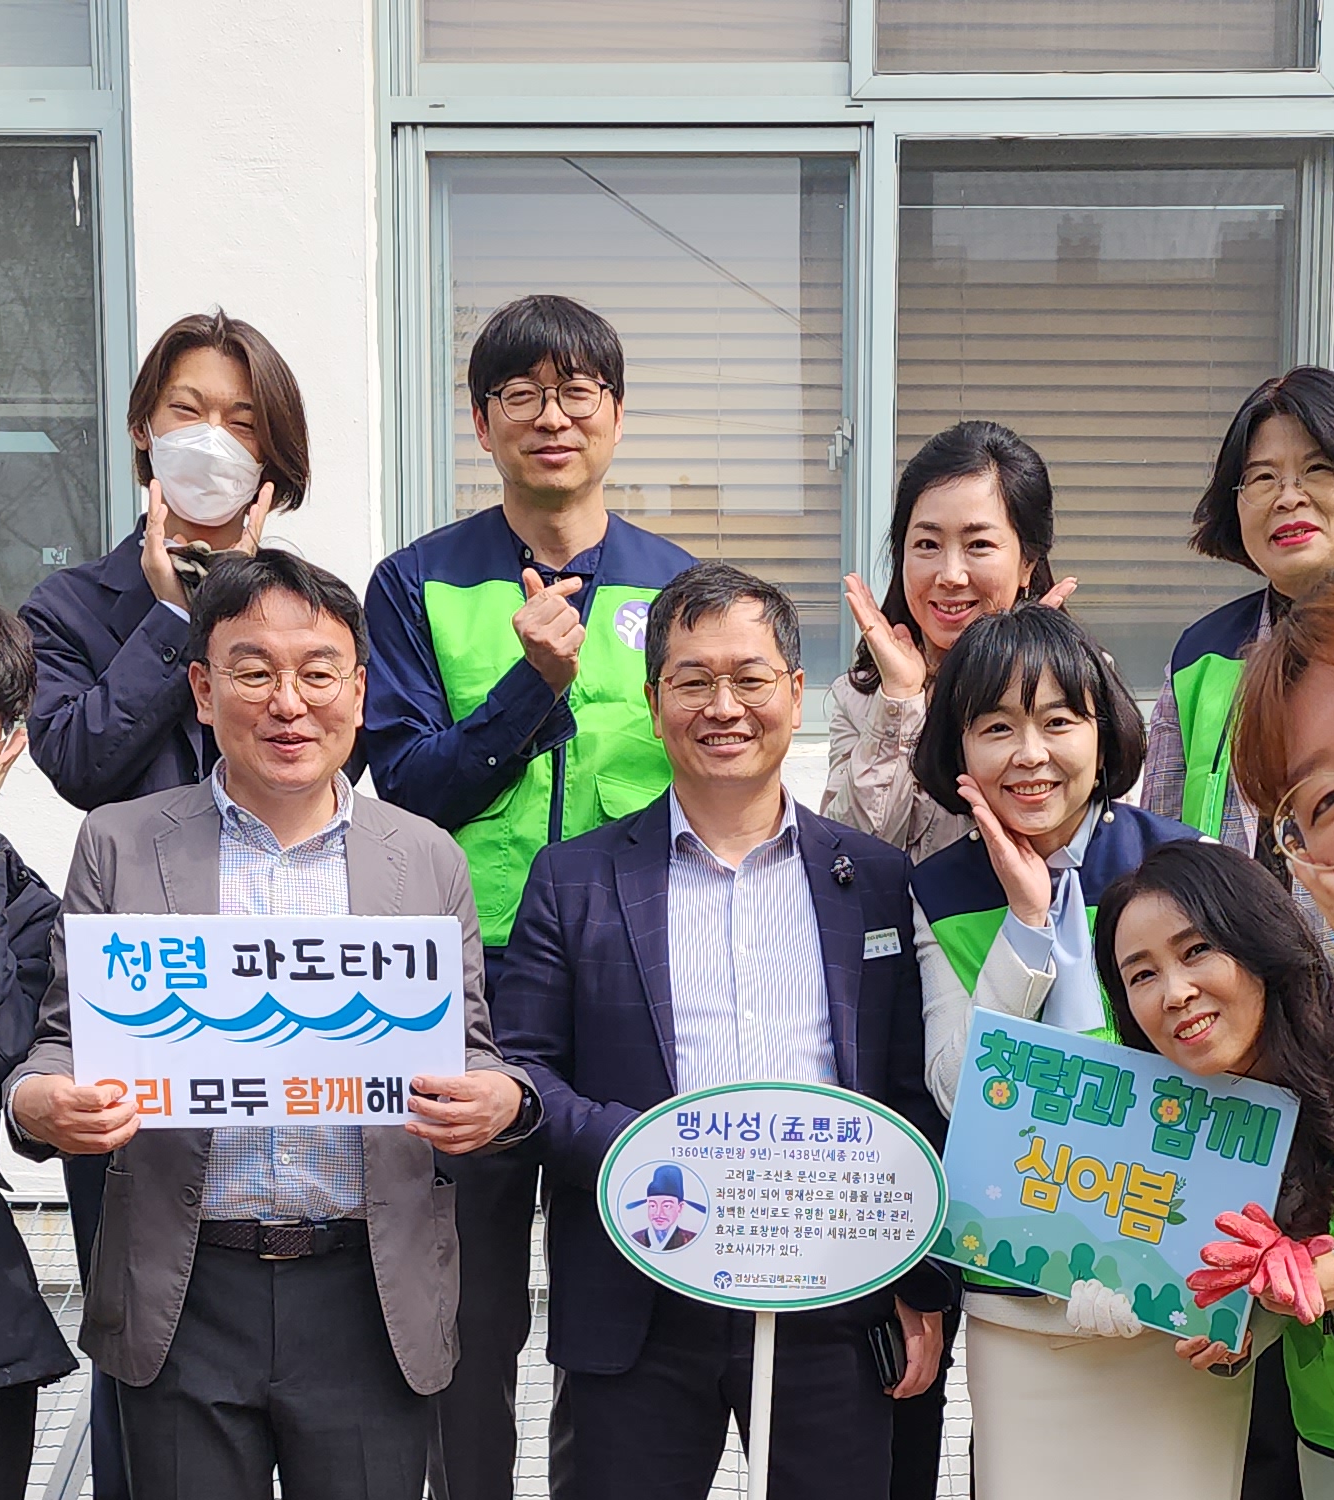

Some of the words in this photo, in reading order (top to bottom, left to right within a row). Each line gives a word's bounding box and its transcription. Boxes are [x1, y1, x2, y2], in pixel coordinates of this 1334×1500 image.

[101, 931, 208, 991] 청렴
[230, 937, 439, 982] 파도타기
[188, 1078, 269, 1117] 모두
[975, 1029, 1137, 1127] 청렴과
[1149, 1074, 1282, 1167] 함께
[676, 1110, 874, 1145] 맹사성(孟思誠)
[851, 1149, 880, 1163] 20년)
[797, 1170, 837, 1184] 문신으로
[1014, 1135, 1179, 1245] 심어봄
[760, 1188, 780, 1201] 되어
[750, 1206, 790, 1220] 선비로도
[856, 1208, 886, 1222] 검소한
[715, 1223, 746, 1237] 효자로
[882, 1228, 902, 1241] 직접
